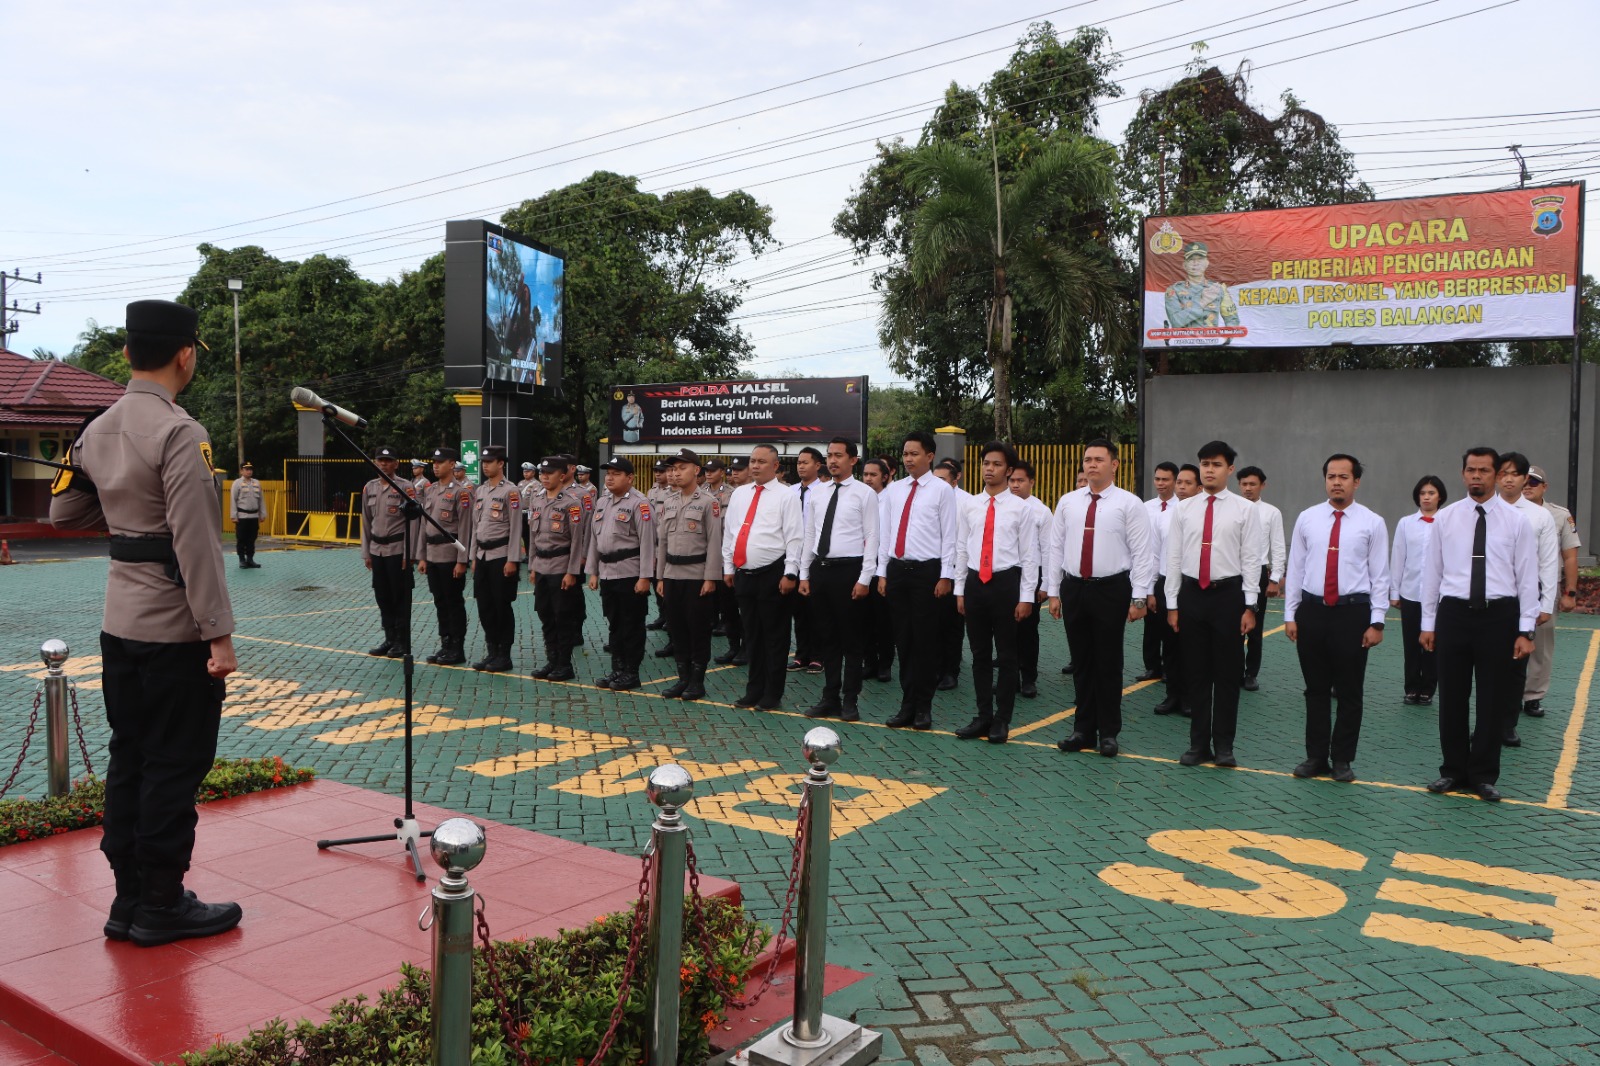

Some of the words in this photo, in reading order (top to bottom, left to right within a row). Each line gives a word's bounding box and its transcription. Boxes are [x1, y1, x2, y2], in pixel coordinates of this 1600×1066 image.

[1328, 217, 1469, 250] UPACARA
[1271, 255, 1377, 280] PEMBERIAN
[1383, 246, 1535, 275] PENGHARGAAN
[1238, 287, 1299, 307] KEPADA
[1303, 282, 1389, 303] PERSONEL
[1393, 280, 1439, 300] YANG
[1444, 273, 1567, 298] BERPRESTASI
[1307, 308, 1376, 328] POLRES
[1381, 304, 1483, 327] BALANGAN
[680, 385, 729, 397] POLDA
[732, 382, 789, 394] KALSEL
[660, 398, 714, 410] Bertakwa,
[715, 396, 749, 409] Loyal,
[751, 394, 820, 406] Profesional,
[660, 412, 687, 423] Solid
[688, 411, 696, 422] &
[698, 410, 736, 424] Sinergi
[738, 409, 773, 420] Untuk
[661, 426, 712, 437] Indonesia
[714, 425, 743, 435] Emas
